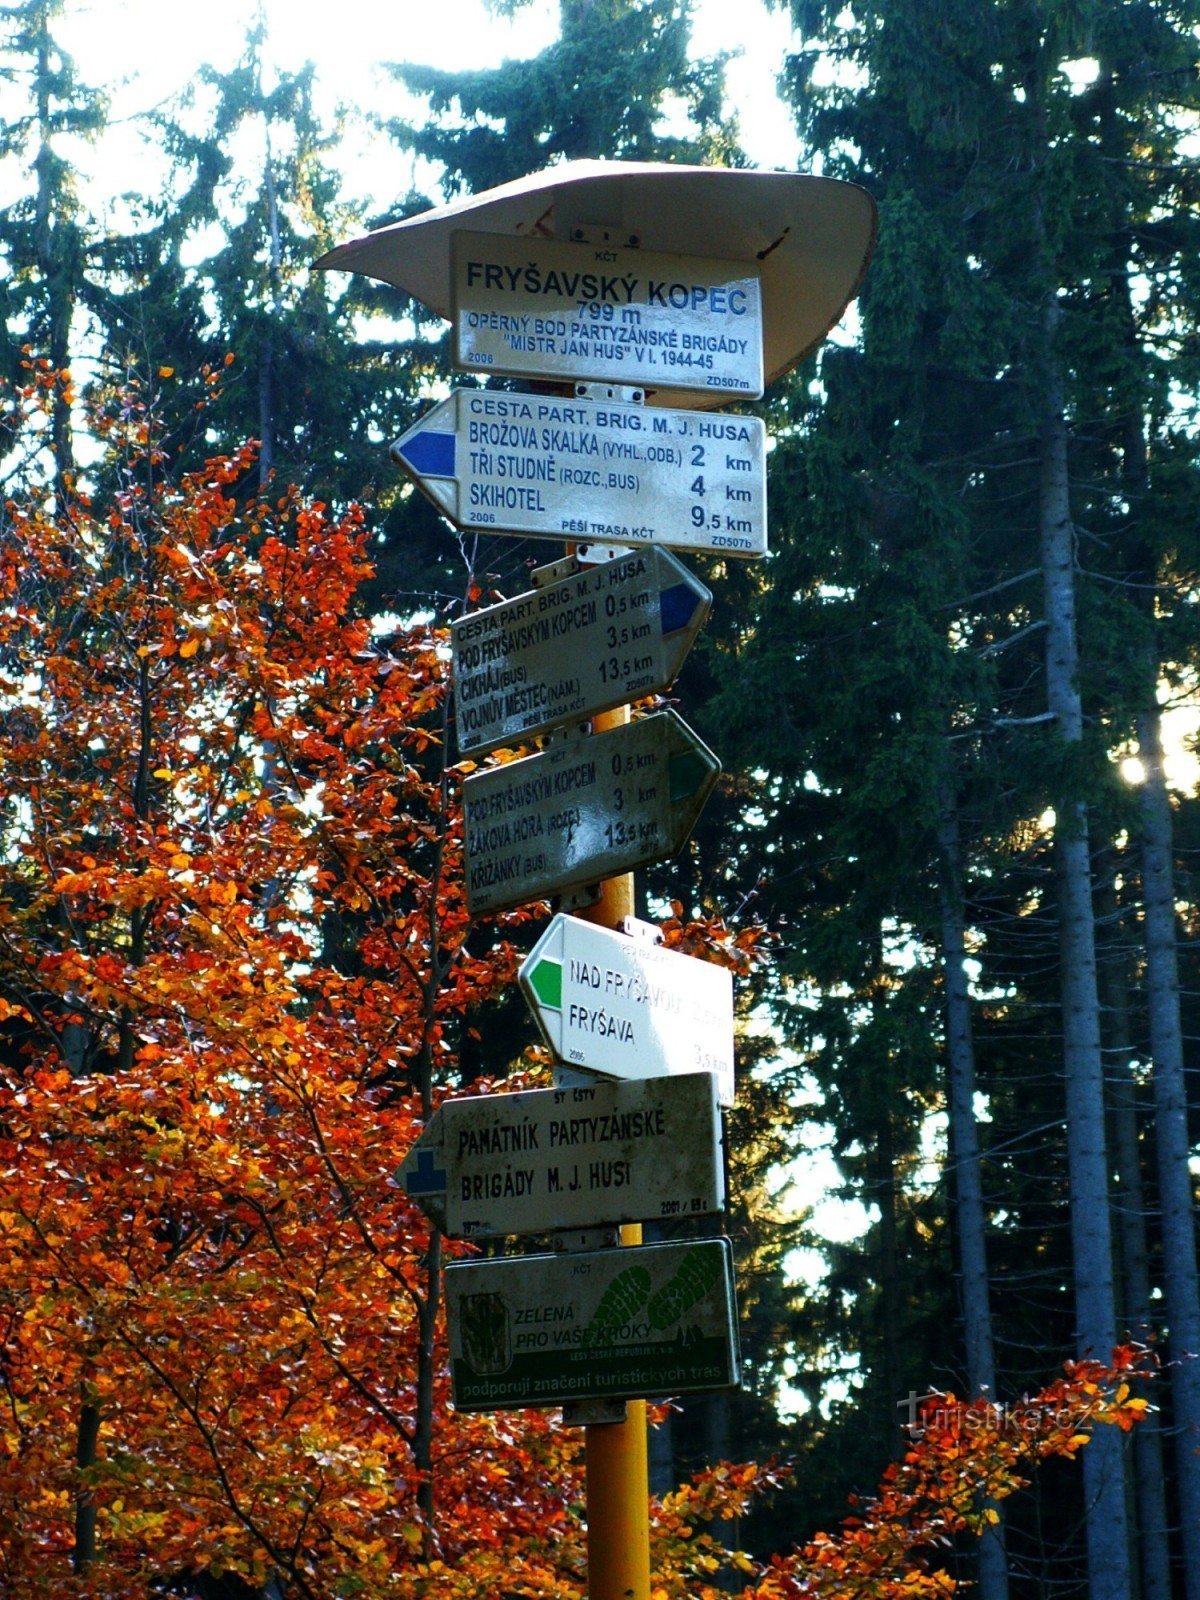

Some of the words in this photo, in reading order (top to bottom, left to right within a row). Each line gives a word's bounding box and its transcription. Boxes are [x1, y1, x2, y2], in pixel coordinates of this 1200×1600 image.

[595, 251, 616, 262] KČT
[467, 262, 638, 303] FRYŠAVSKÝ
[649, 281, 747, 315] KOPEC
[577, 301, 615, 321] 799
[622, 310, 641, 325] m
[468, 312, 529, 332] OPĚRNÝ
[535, 318, 566, 336] BOD
[571, 323, 676, 347] PARTYZÁNSKÉ
[682, 335, 748, 355] BRIGÁDY
[503, 333, 555, 352] "MISTR
[560, 341, 589, 357] JAN
[595, 344, 631, 360] HUS"
[635, 347, 648, 362] V
[662, 351, 713, 369] 1944-45
[468, 353, 494, 364] 2006
[707, 376, 749, 389] ZD507m
[471, 399, 532, 419] CESTA
[539, 406, 589, 425] PART.
[597, 412, 647, 432] BRIG.
[653, 417, 672, 433] M.
[678, 421, 693, 436] J.
[699, 422, 750, 442] HUSA
[469, 420, 537, 449] BROŽOVA
[542, 430, 599, 455] SKALKA
[603, 442, 682, 468] (VYHL.,ODB.)
[691, 445, 706, 467] 2
[726, 455, 751, 471] km
[470, 450, 493, 476] TŘI
[560, 468, 639, 494] (ROZC.,BUS)
[691, 476, 706, 497] 4
[726, 486, 751, 502] km
[470, 483, 545, 512] SKIHOTEL
[691, 506, 720, 532] 9,5
[726, 515, 752, 532] km
[470, 512, 495, 523] 2006
[562, 520, 587, 532] PĚŠÍ
[590, 523, 629, 537] TRASA
[632, 526, 654, 539] KČT
[711, 536, 751, 548] ZD507b
[458, 617, 497, 642] CESTA
[500, 601, 537, 626] PART.
[539, 588, 573, 614] BRIG.
[577, 581, 592, 596] M.
[595, 576, 605, 589] J.
[608, 559, 646, 584] HUSA
[458, 644, 481, 672] POD
[552, 602, 598, 638] KOPCEM
[605, 594, 628, 617] 0,5
[629, 592, 649, 608] km
[500, 666, 527, 690] (BUS)
[607, 626, 629, 648] 3,5
[631, 623, 650, 639] km
[505, 680, 548, 718] MĚSTEC
[599, 658, 631, 683] 13,5
[633, 655, 653, 672] km
[544, 705, 569, 723] TRASA
[570, 698, 586, 712] KČT
[468, 793, 492, 823] POD
[554, 761, 596, 792] KOPCEM
[611, 754, 634, 775] 0,5
[636, 753, 655, 767] km
[468, 825, 510, 858] ŽÁKOVA
[513, 816, 544, 843] HORA
[613, 788, 623, 811] 3
[638, 787, 656, 802] km
[604, 824, 636, 849] 13,5
[639, 822, 657, 838] km
[570, 959, 600, 989] NAD
[570, 1004, 635, 1045] FRYŠAVA
[458, 1116, 538, 1160] PAMÁTNÍK
[550, 1102, 666, 1147] PARTYZÁNSKÉ
[462, 1164, 534, 1200] BRIGÁDY
[548, 1166, 564, 1192] M.
[568, 1166, 582, 1190] J.
[516, 1302, 574, 1325] ZELENÁ
[516, 1332, 548, 1348] PRO
[596, 1322, 653, 1342] KROKY
[463, 1378, 530, 1400] podporují
[534, 1372, 591, 1392] značení
[596, 1364, 686, 1388] turistických
[690, 1364, 721, 1380] tras
